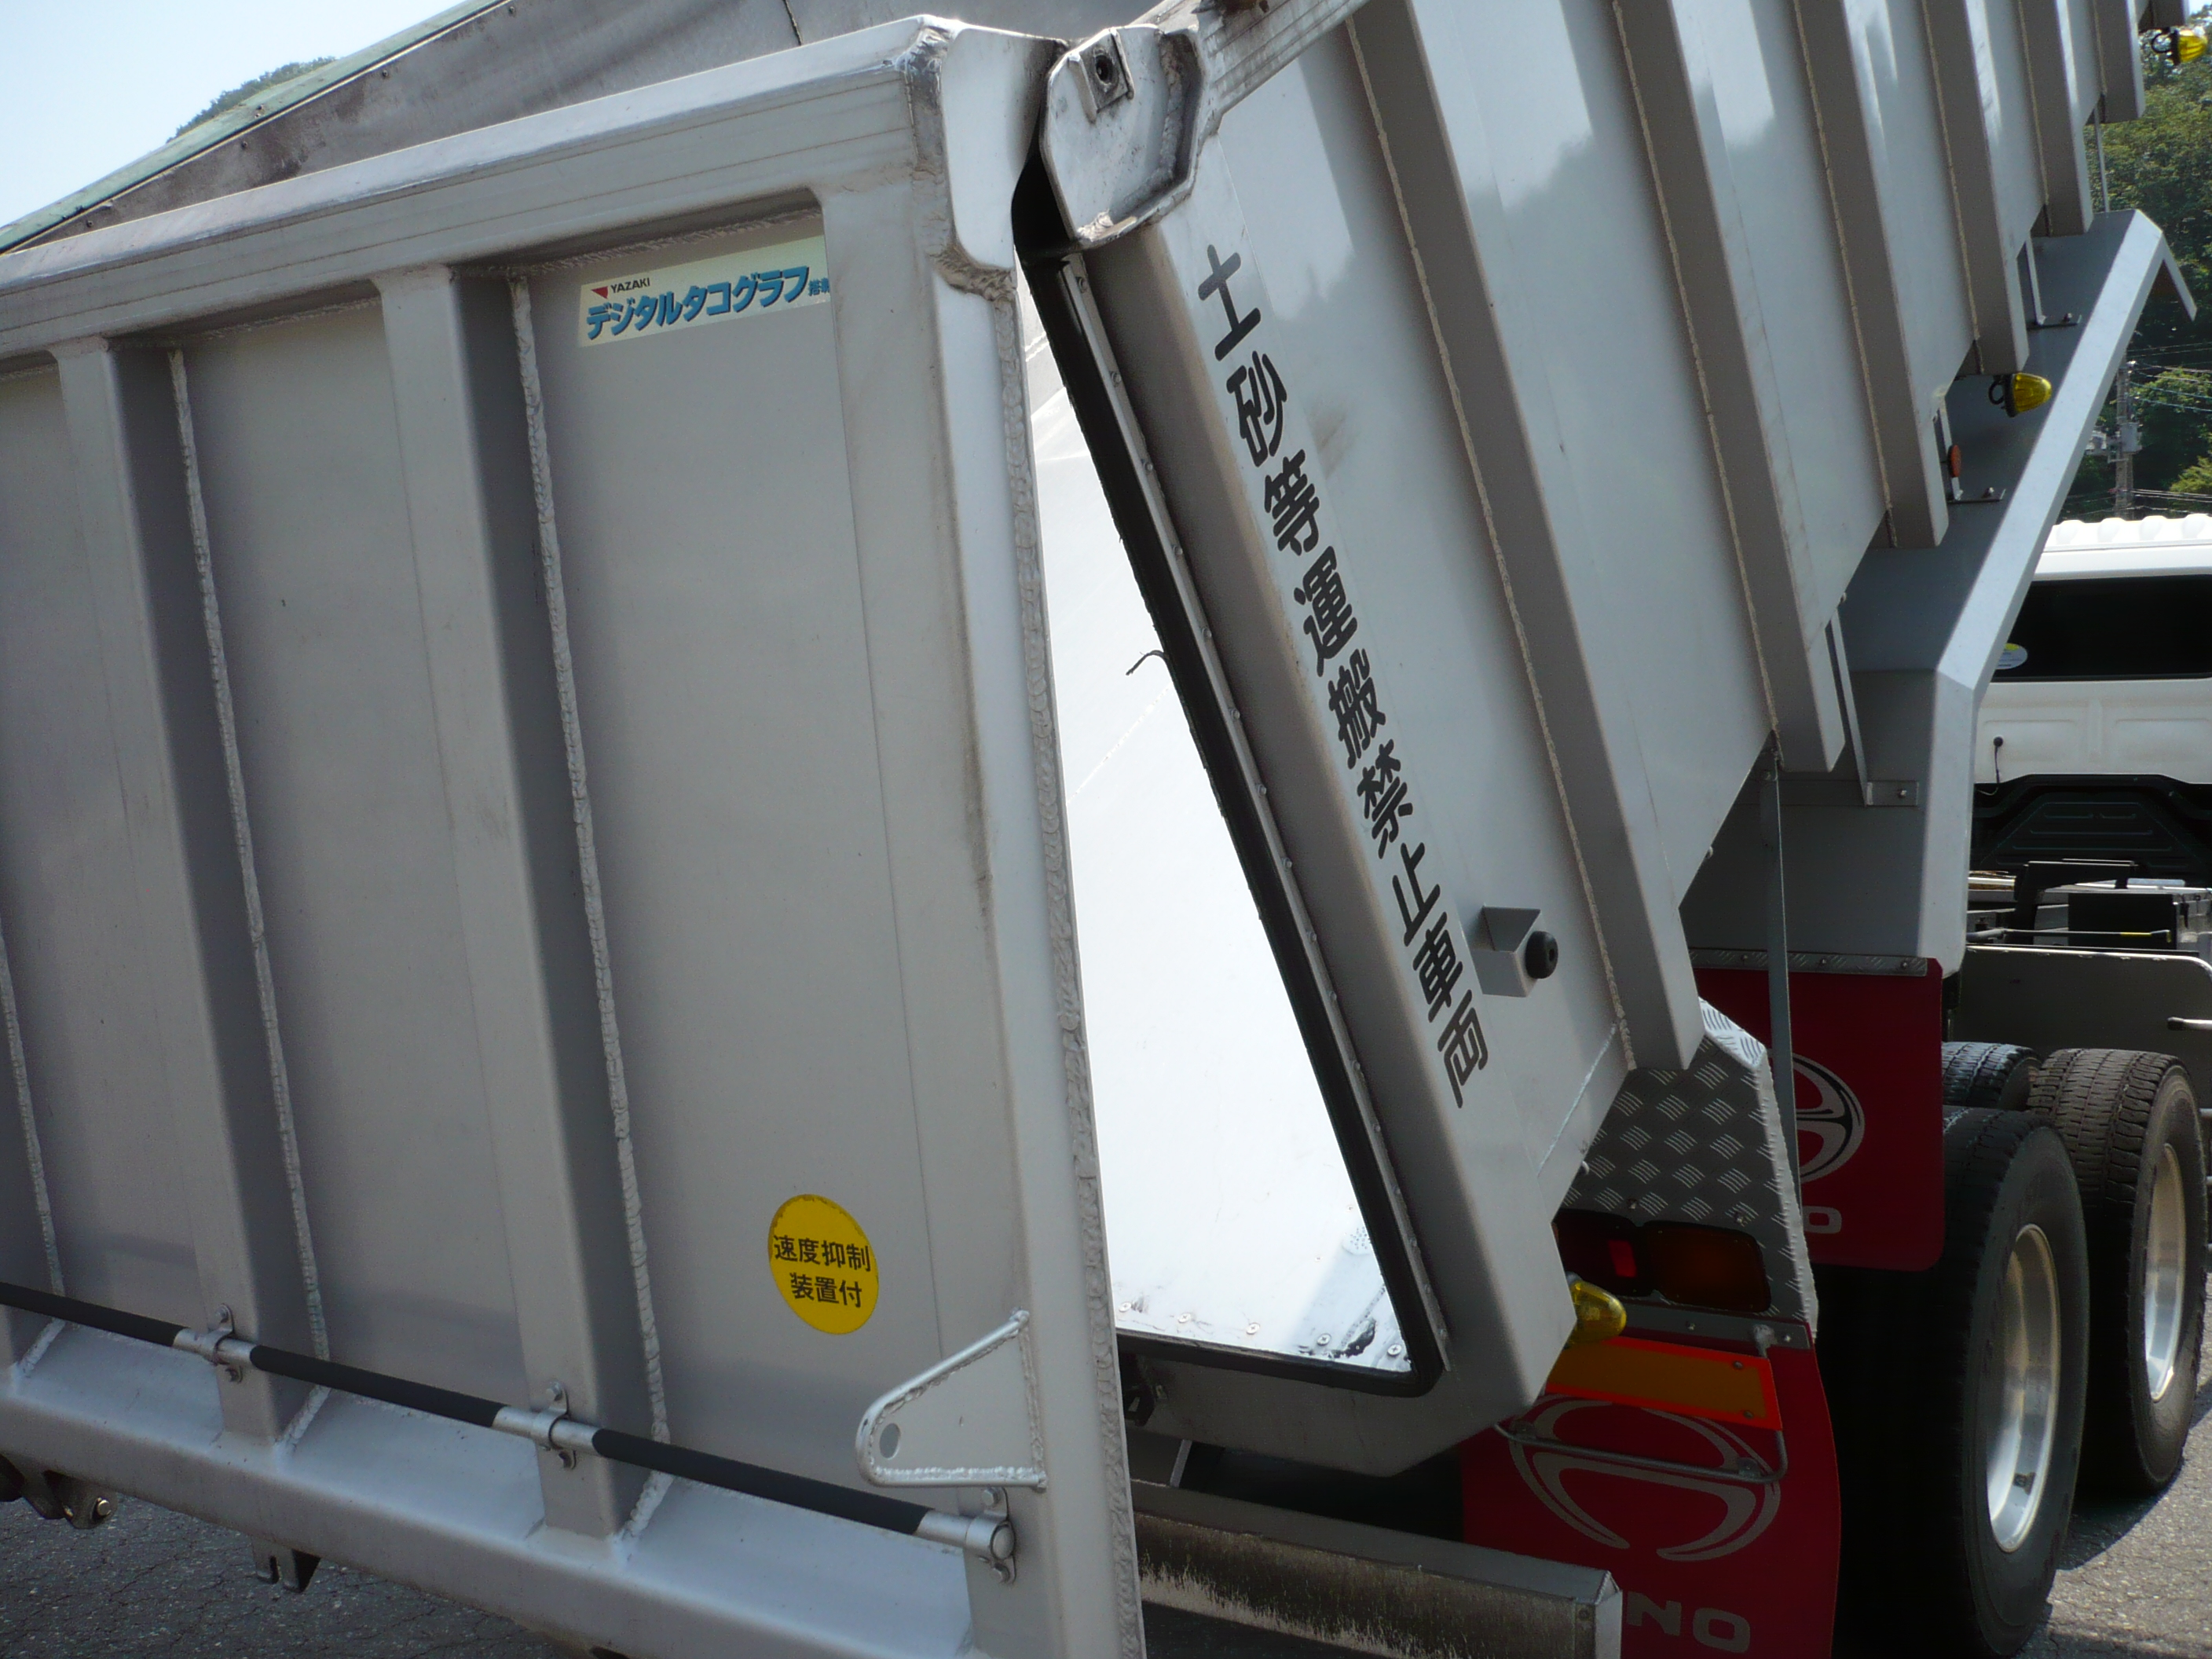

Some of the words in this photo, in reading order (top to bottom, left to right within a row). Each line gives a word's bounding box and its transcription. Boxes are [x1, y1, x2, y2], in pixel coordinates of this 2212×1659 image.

[610, 277, 650, 294] YAZAKI
[1197, 244, 1488, 1108] 土砂等運搬禁止車両
[773, 1234, 871, 1272] 速度抑制
[789, 1272, 862, 1309] 装置付
